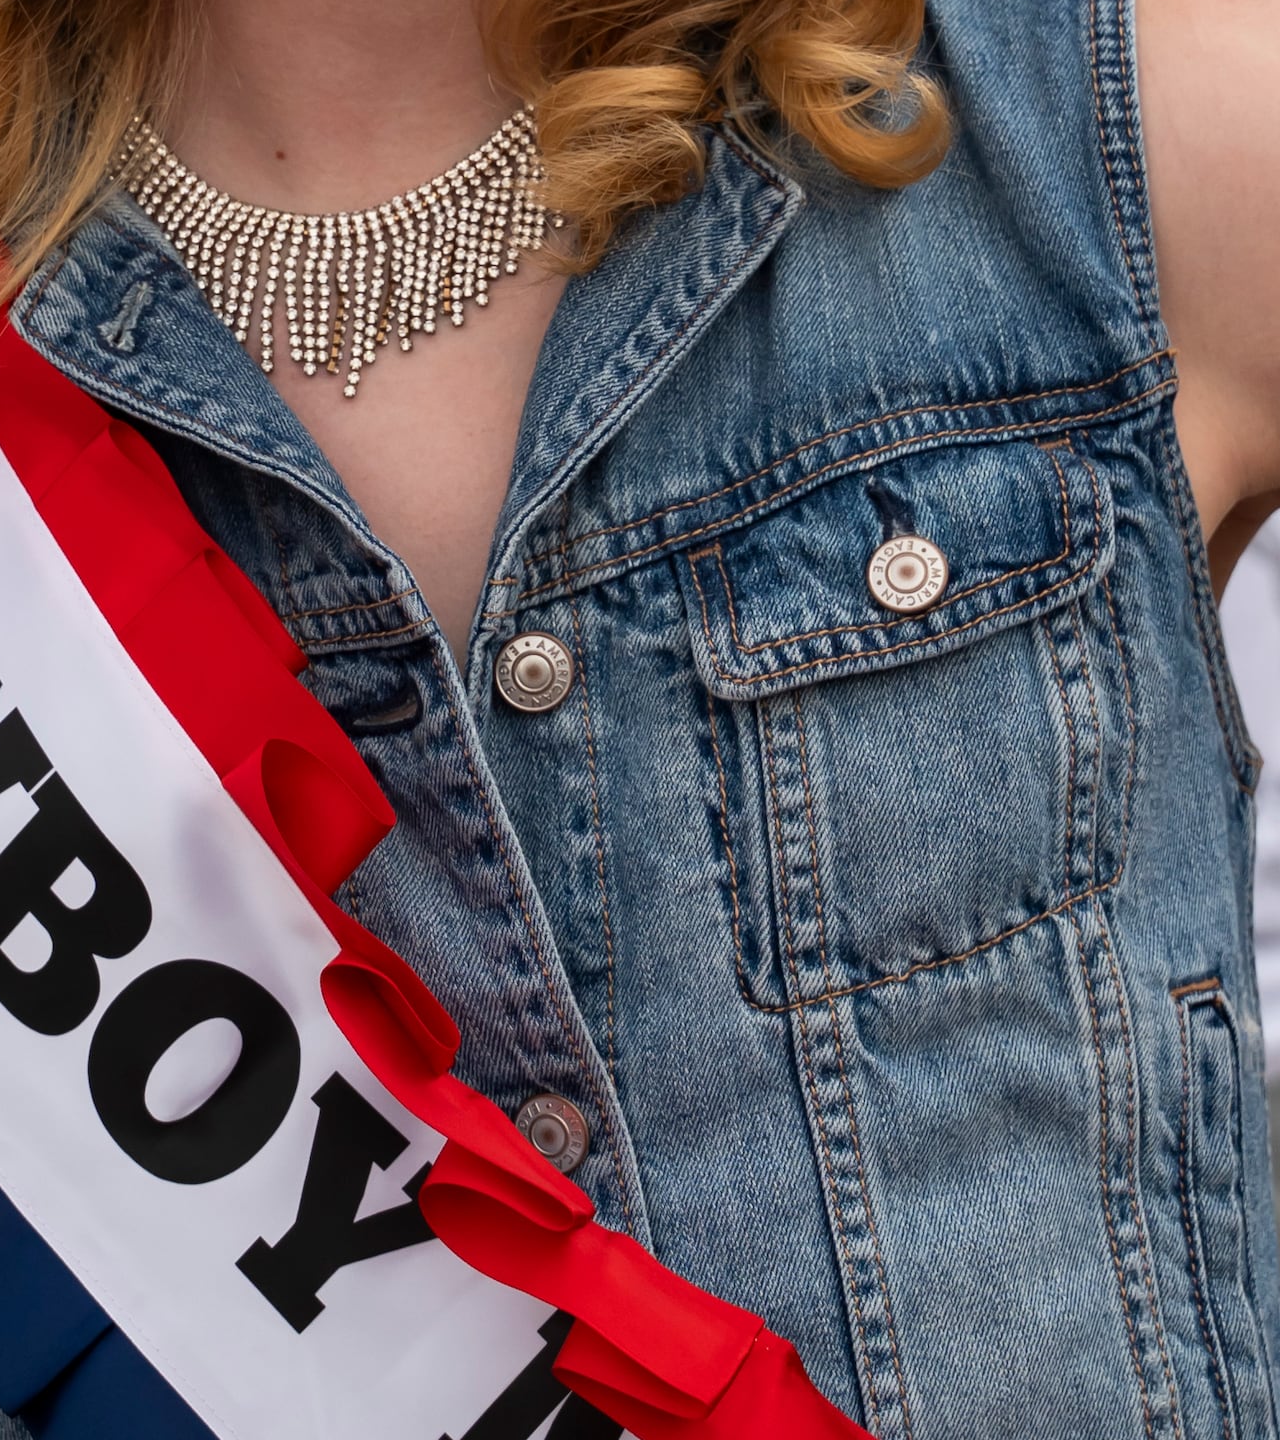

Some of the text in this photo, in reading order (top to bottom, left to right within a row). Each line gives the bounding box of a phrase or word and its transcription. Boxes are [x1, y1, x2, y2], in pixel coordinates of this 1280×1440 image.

[872, 540, 942, 607] AMERICAN EAGLE
[499, 639, 569, 708] AMERICAN EAGLE
